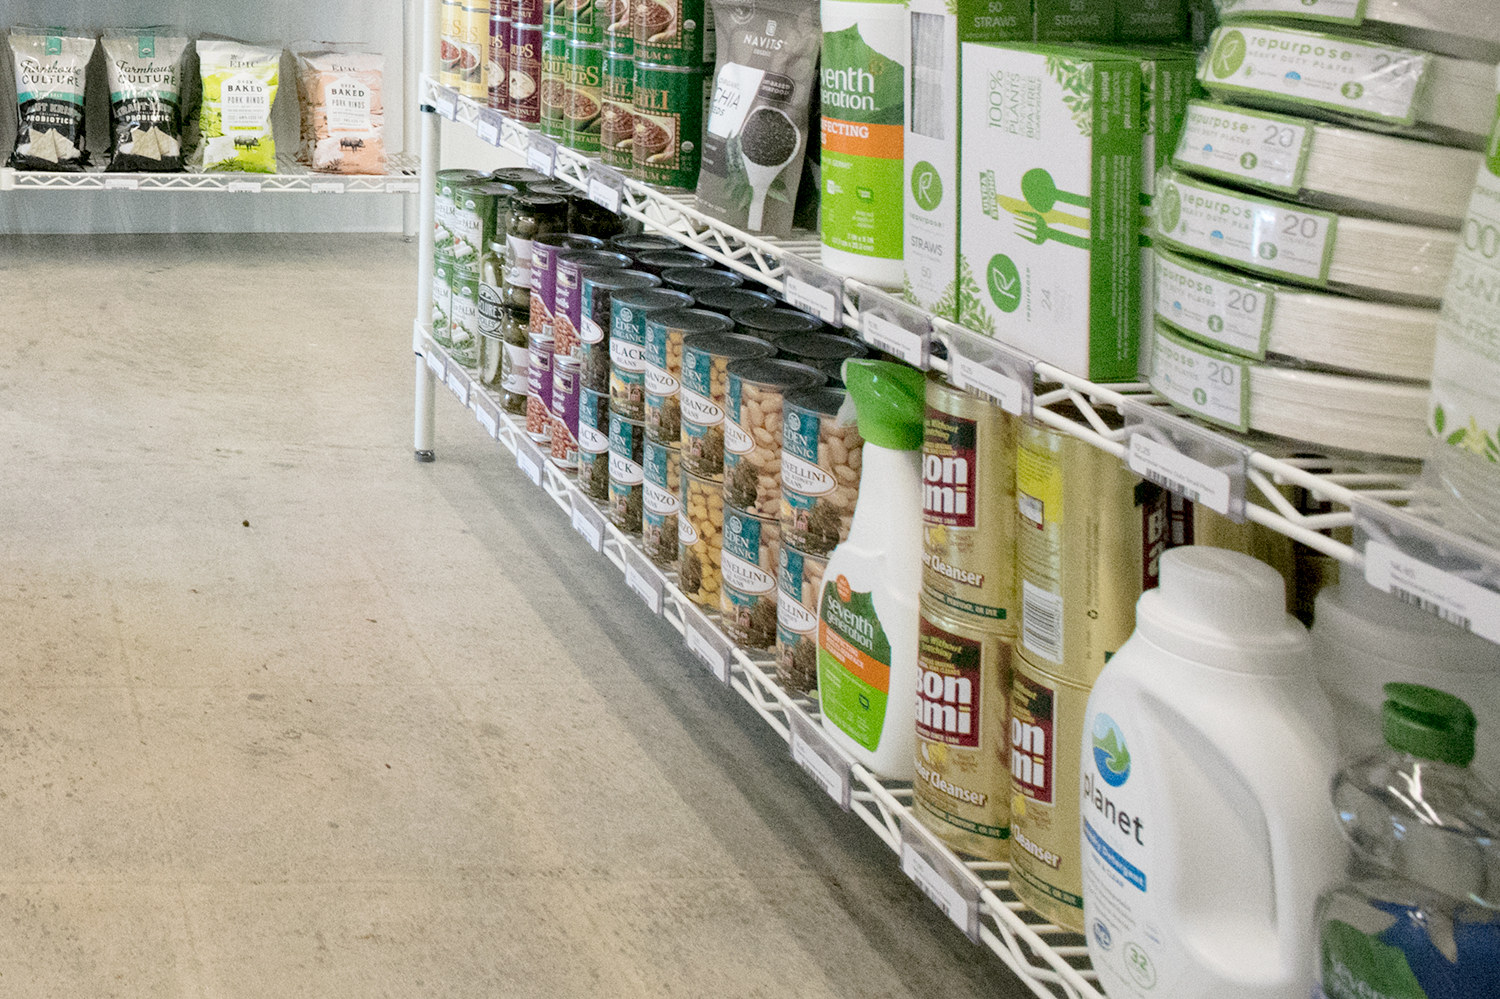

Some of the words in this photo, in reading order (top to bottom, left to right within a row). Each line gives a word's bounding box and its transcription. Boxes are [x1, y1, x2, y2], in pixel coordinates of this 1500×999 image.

[974, 16, 1017, 29] STRAWS
[1250, 36, 1352, 61] repurpose
[21, 74, 80, 89] CULTURE
[118, 74, 177, 88] CULTURE
[227, 84, 263, 95] BAKED
[331, 87, 365, 98] BAKED
[227, 95, 245, 105] PORK
[247, 95, 265, 105] RINDS
[331, 99, 347, 109] PORK
[350, 99, 365, 109] RINDS
[1282, 212, 1318, 239] 20
[910, 236, 942, 256] STRAWS
[615, 318, 641, 334] EDEN
[931, 555, 983, 587] Cleanser
[931, 773, 987, 807] Cleanser
[1084, 772, 1144, 846] planet
